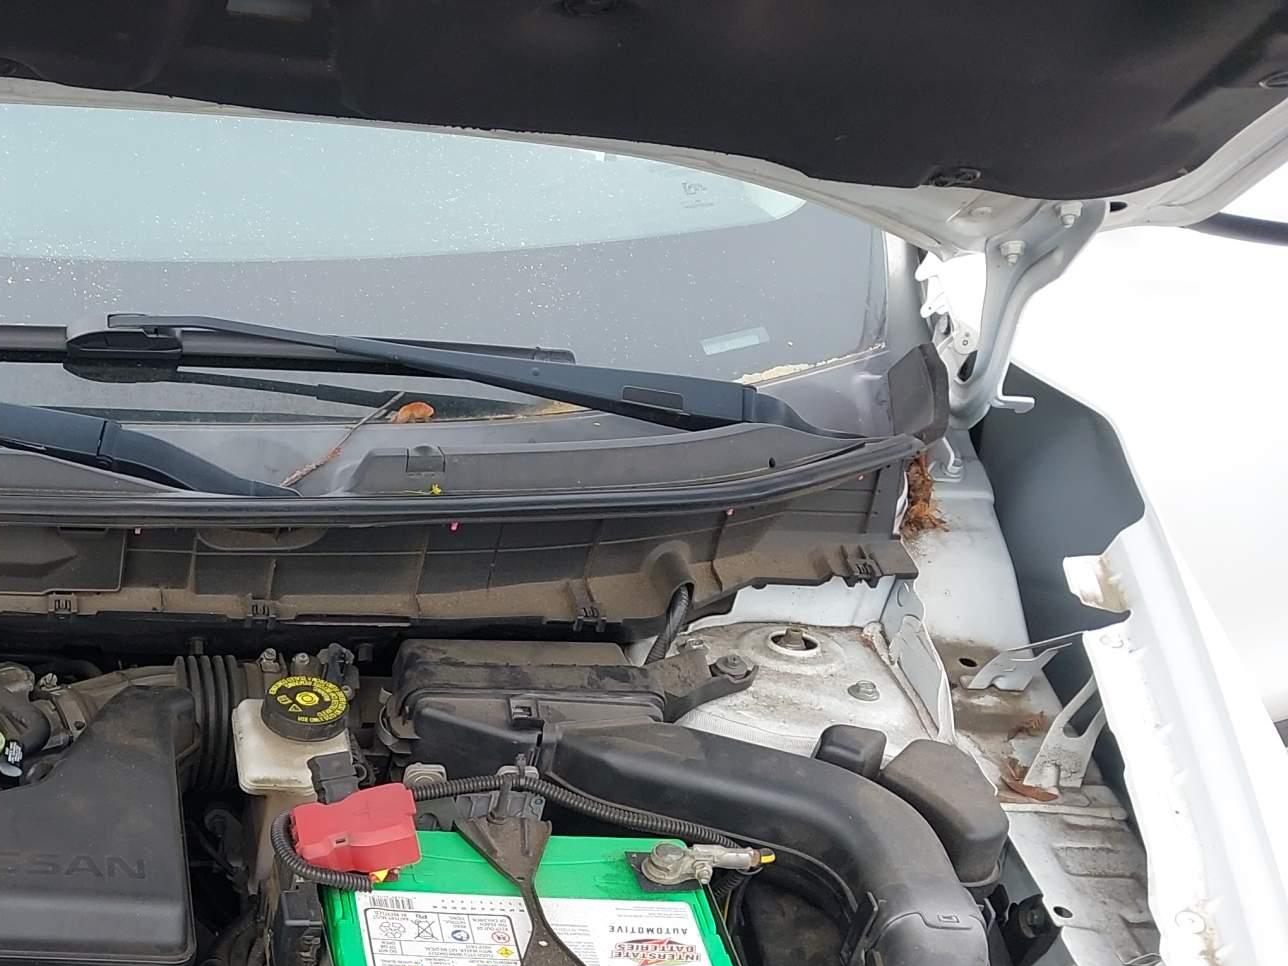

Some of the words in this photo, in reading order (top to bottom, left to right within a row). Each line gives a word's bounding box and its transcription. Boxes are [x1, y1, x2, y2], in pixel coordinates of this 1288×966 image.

[608, 925, 688, 935] AUTOMOTIVE
[615, 943, 697, 952] BATTERIES
[613, 951, 701, 961] INTERSTATE
